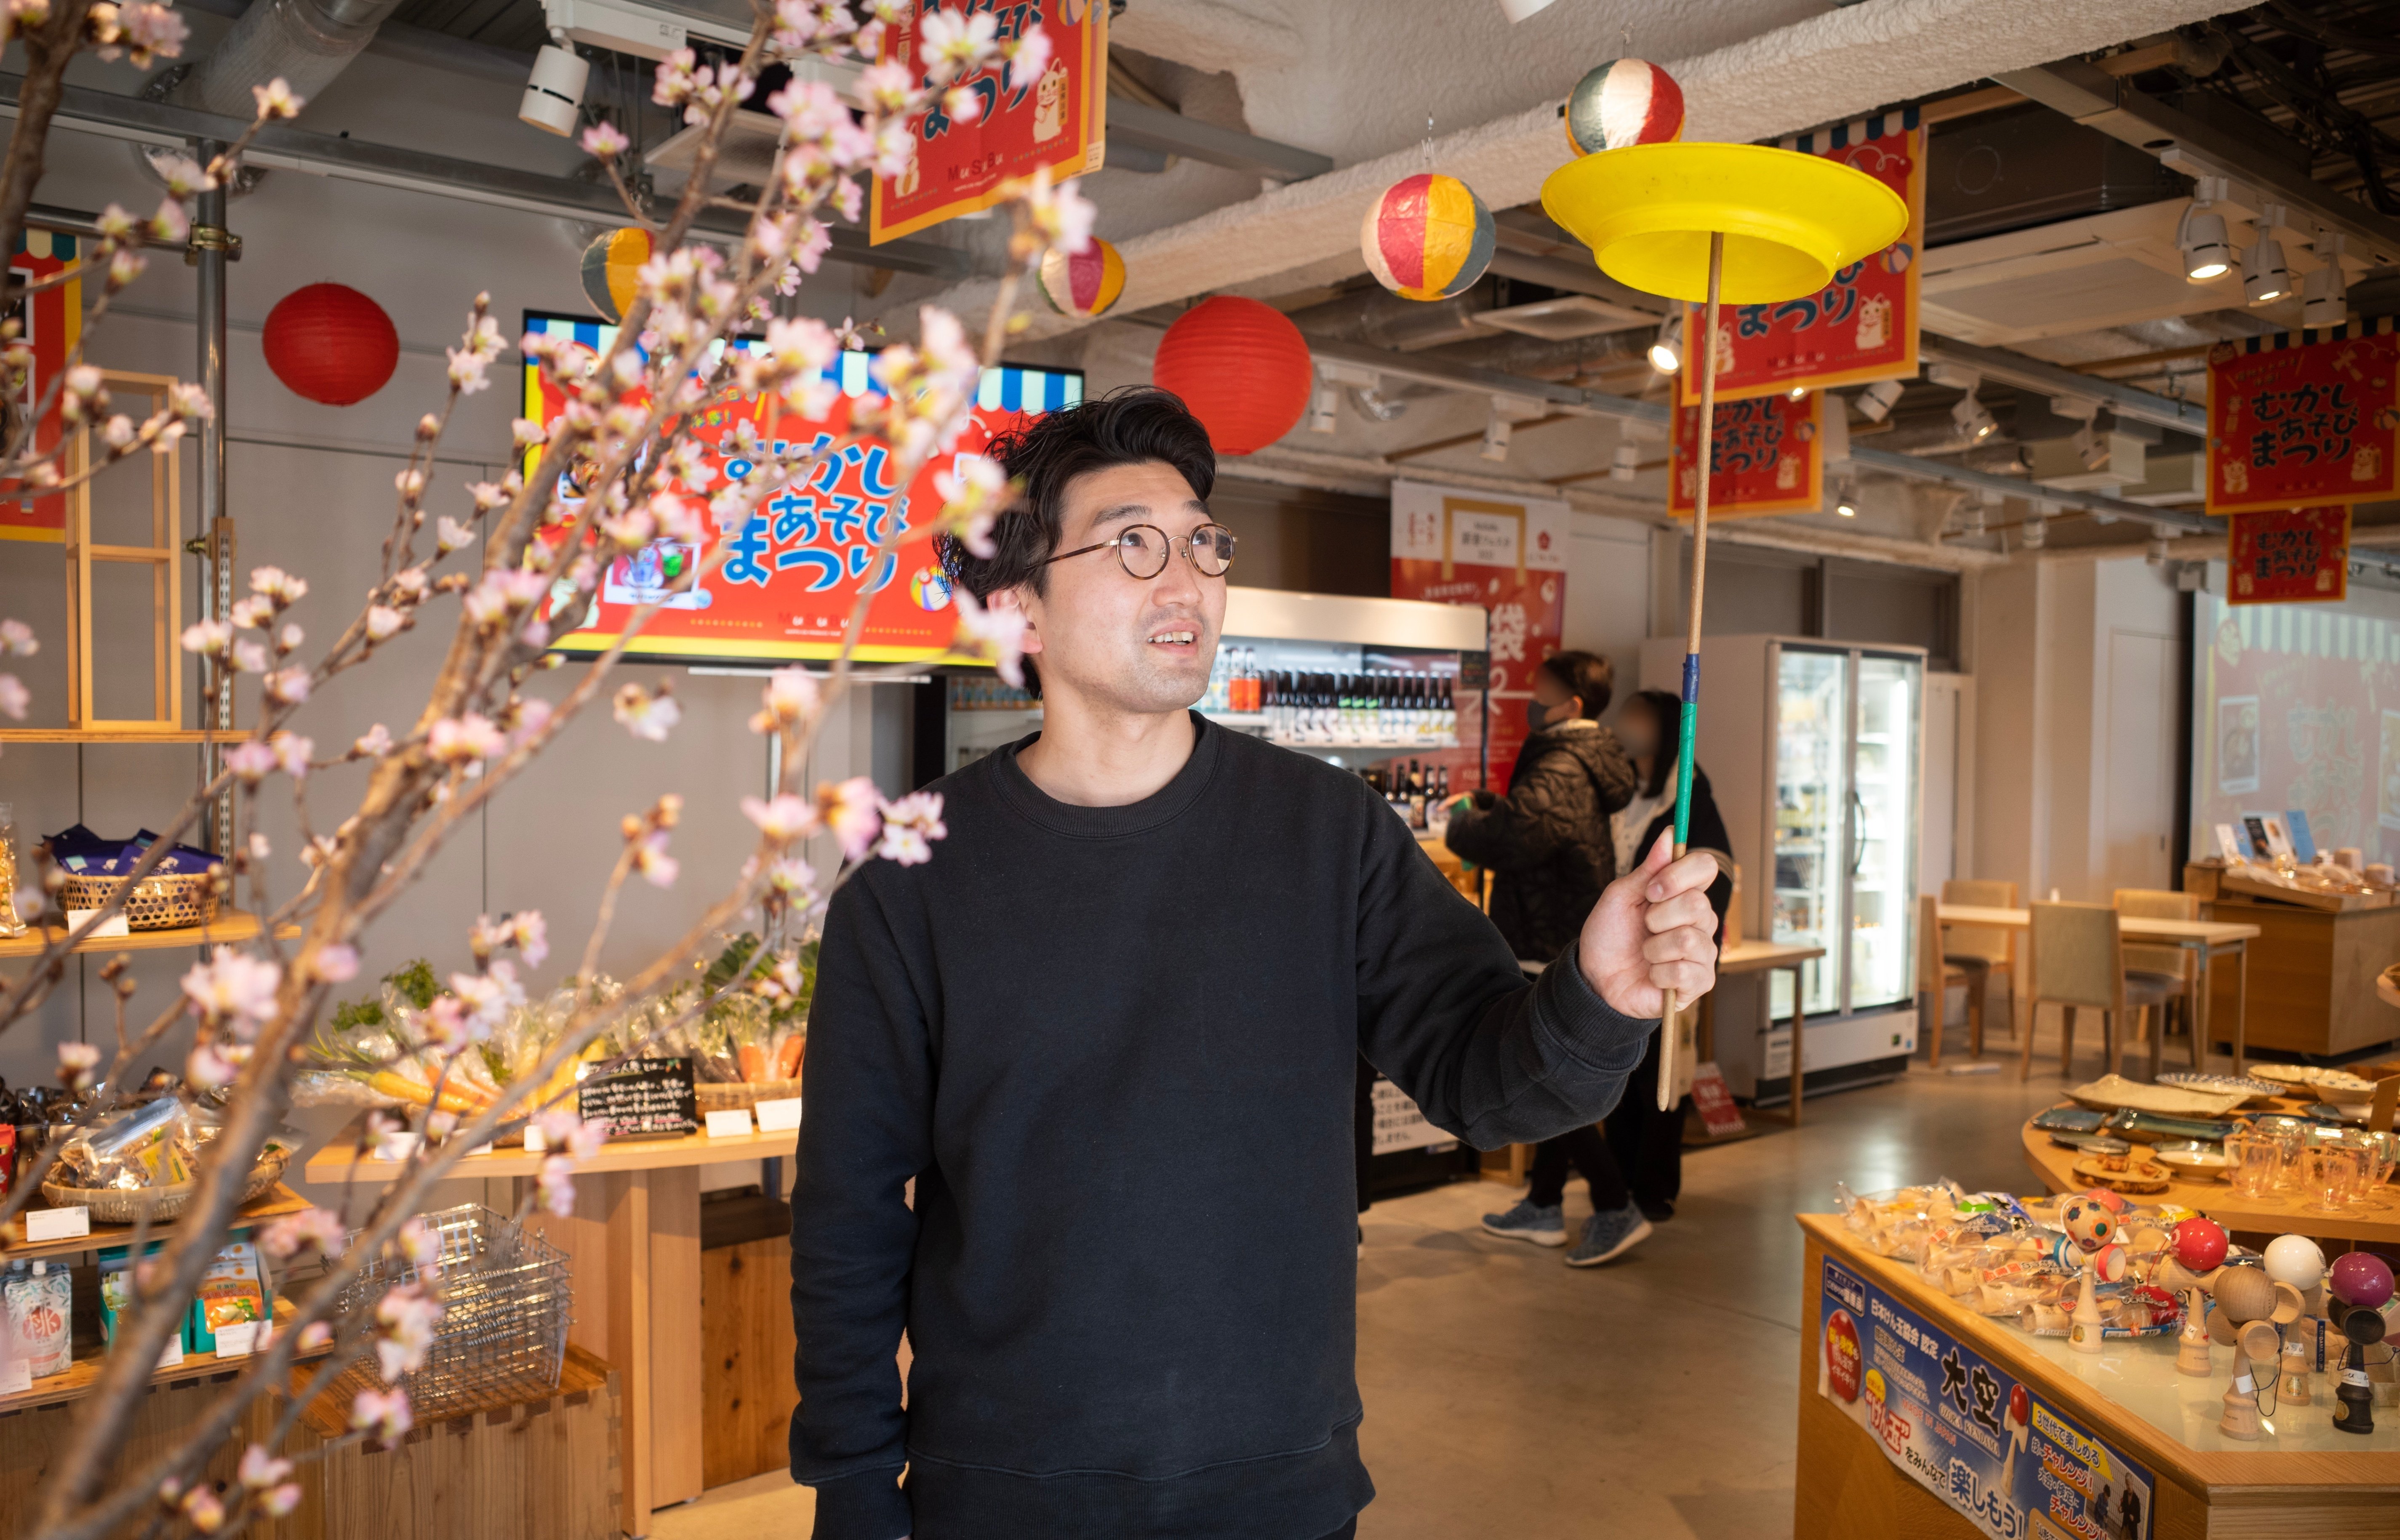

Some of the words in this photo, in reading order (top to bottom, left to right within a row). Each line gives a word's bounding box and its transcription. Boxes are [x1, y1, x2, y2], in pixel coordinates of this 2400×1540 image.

[2251, 381, 2357, 422] むかし
[2280, 411, 2359, 443] あそび
[2251, 430, 2352, 469] まつり
[770, 492, 910, 547] あそび
[721, 509, 898, 594] まつり
[1942, 1346, 2000, 1437] 大空
[1965, 1420, 2000, 1457] KENDAMA
[2037, 1410, 2100, 1467] 3世代で楽しめる
[1906, 1446, 1947, 1490] をみんなで
